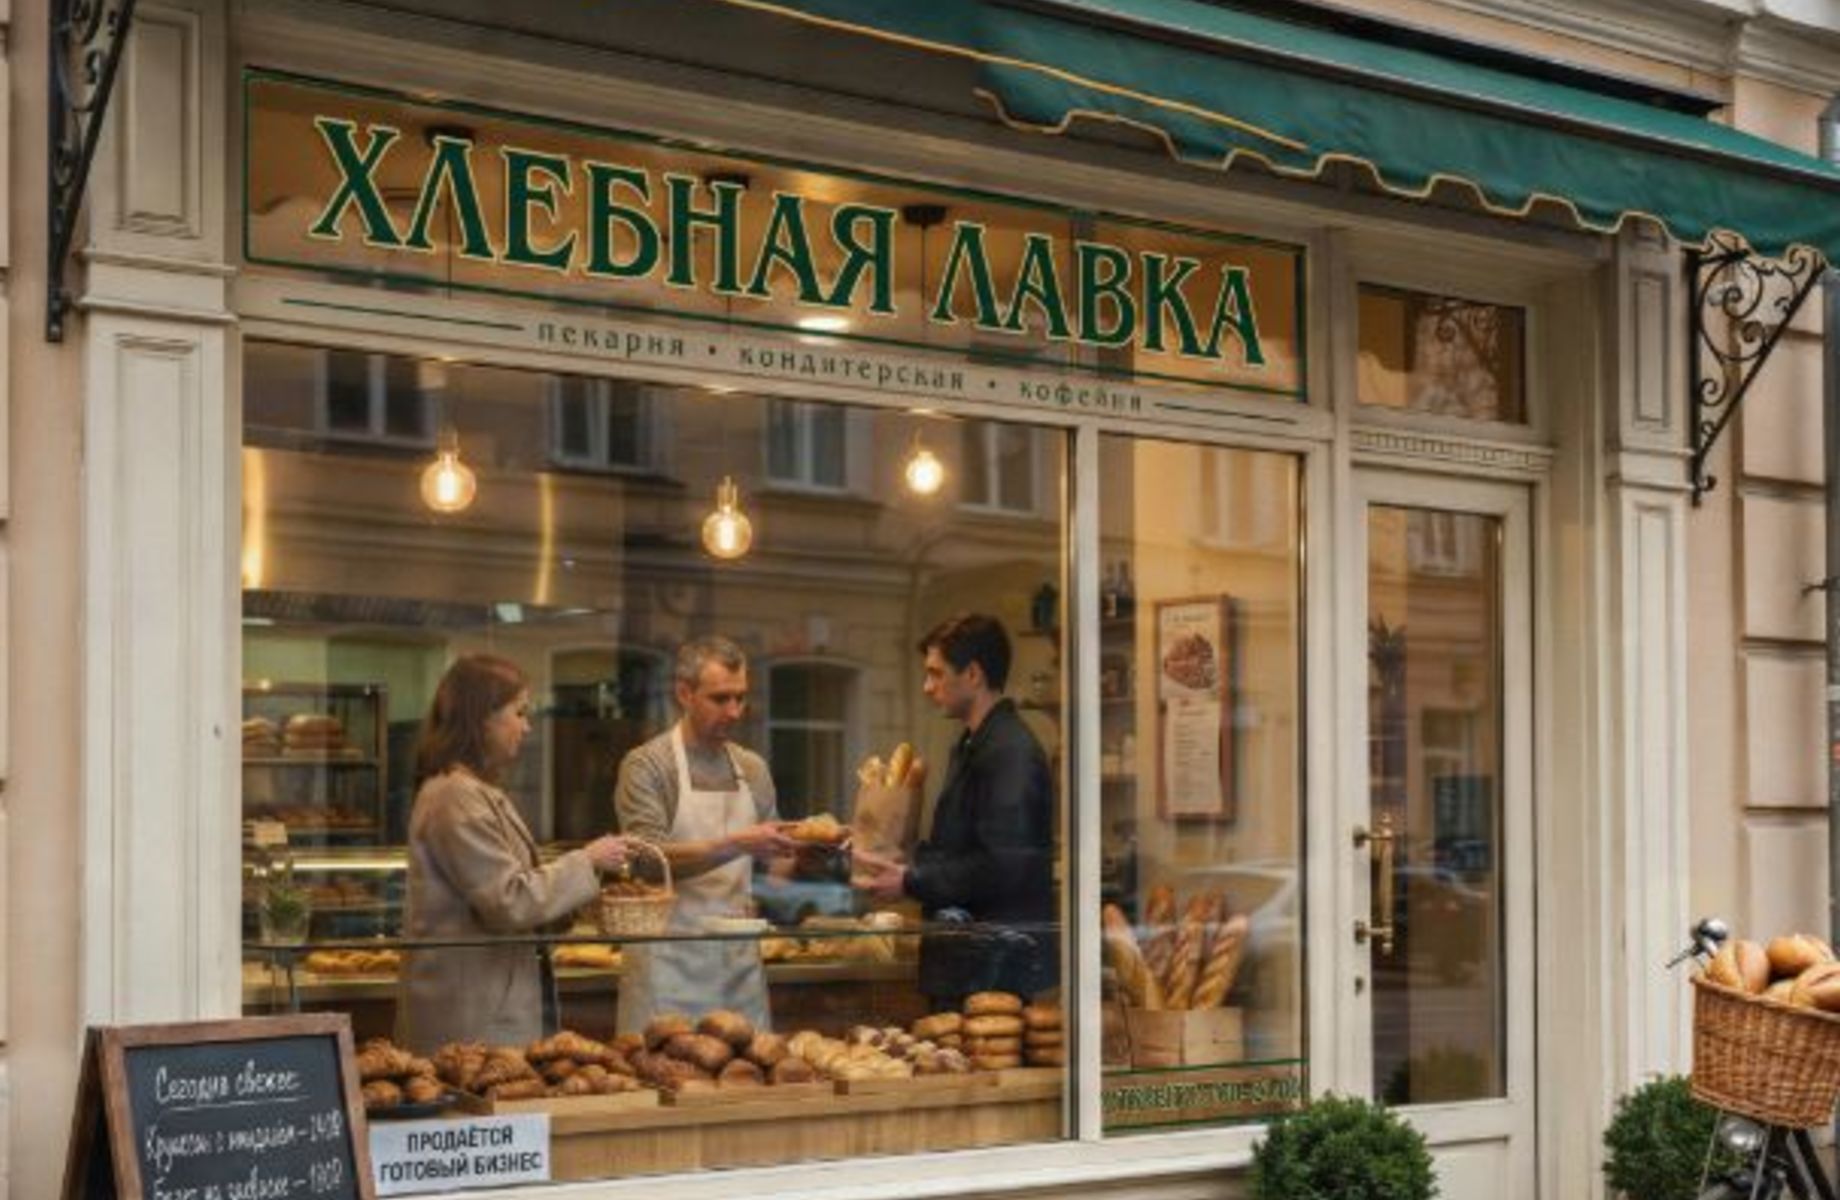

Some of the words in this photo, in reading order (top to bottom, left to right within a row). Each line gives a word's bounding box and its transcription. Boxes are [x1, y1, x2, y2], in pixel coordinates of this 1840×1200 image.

[308, 115, 898, 315] ХЛЕБНАЯ
[930, 220, 1265, 366] ЛАВКА
[537, 322, 684, 359] пекарня
[738, 347, 964, 391] кондитерская
[155, 1065, 230, 1104] Сегодня
[235, 1058, 301, 1097] свежее
[407, 1124, 513, 1153] ПРОДАЁТСЯ
[380, 1152, 470, 1183] ГОТОВЫЙ
[474, 1151, 542, 1176] БИЗНЕС
